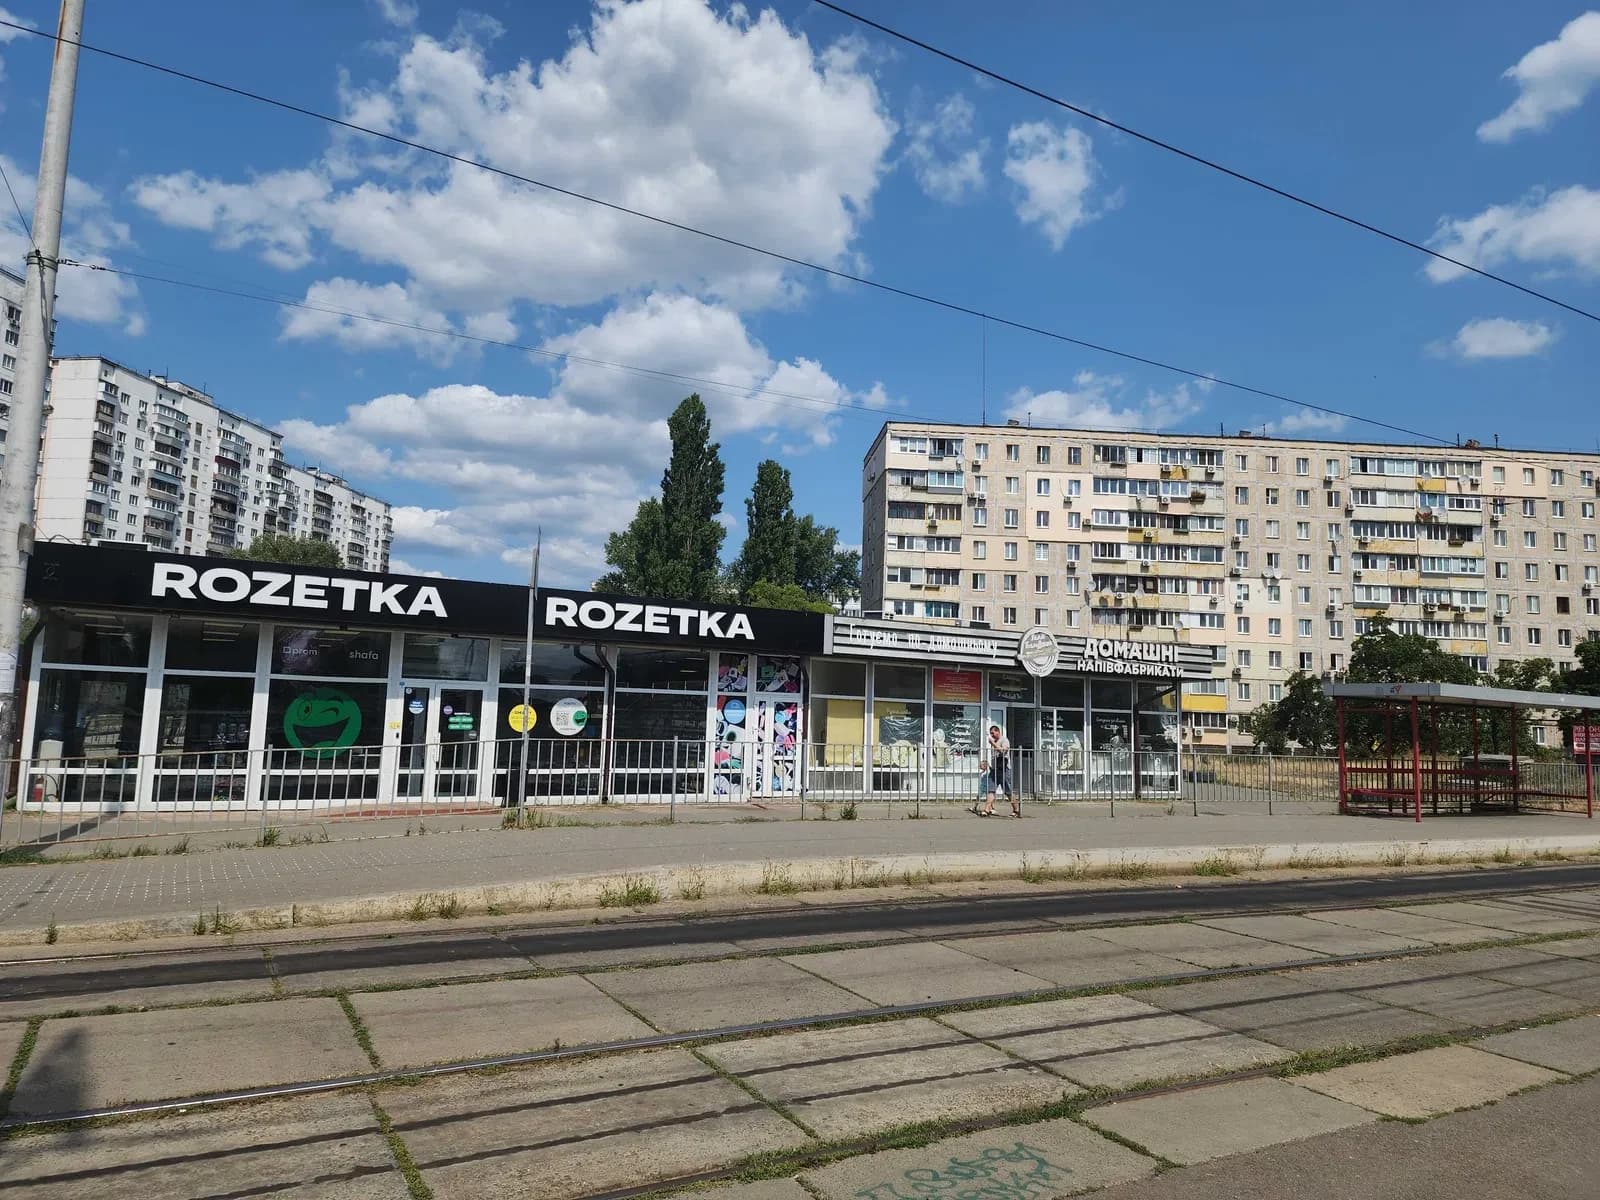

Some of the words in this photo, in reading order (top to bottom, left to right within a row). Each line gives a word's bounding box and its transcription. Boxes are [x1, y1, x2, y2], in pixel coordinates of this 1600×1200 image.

[151, 562, 448, 618] ROZETKA
[545, 596, 755, 640] ROZETKA
[849, 623, 898, 650] Готуємо
[349, 650, 379, 660] shafa
[1083, 637, 1179, 663] ДОМАШНІ
[1077, 658, 1184, 678] НАПІВФАБРИКАТИ
